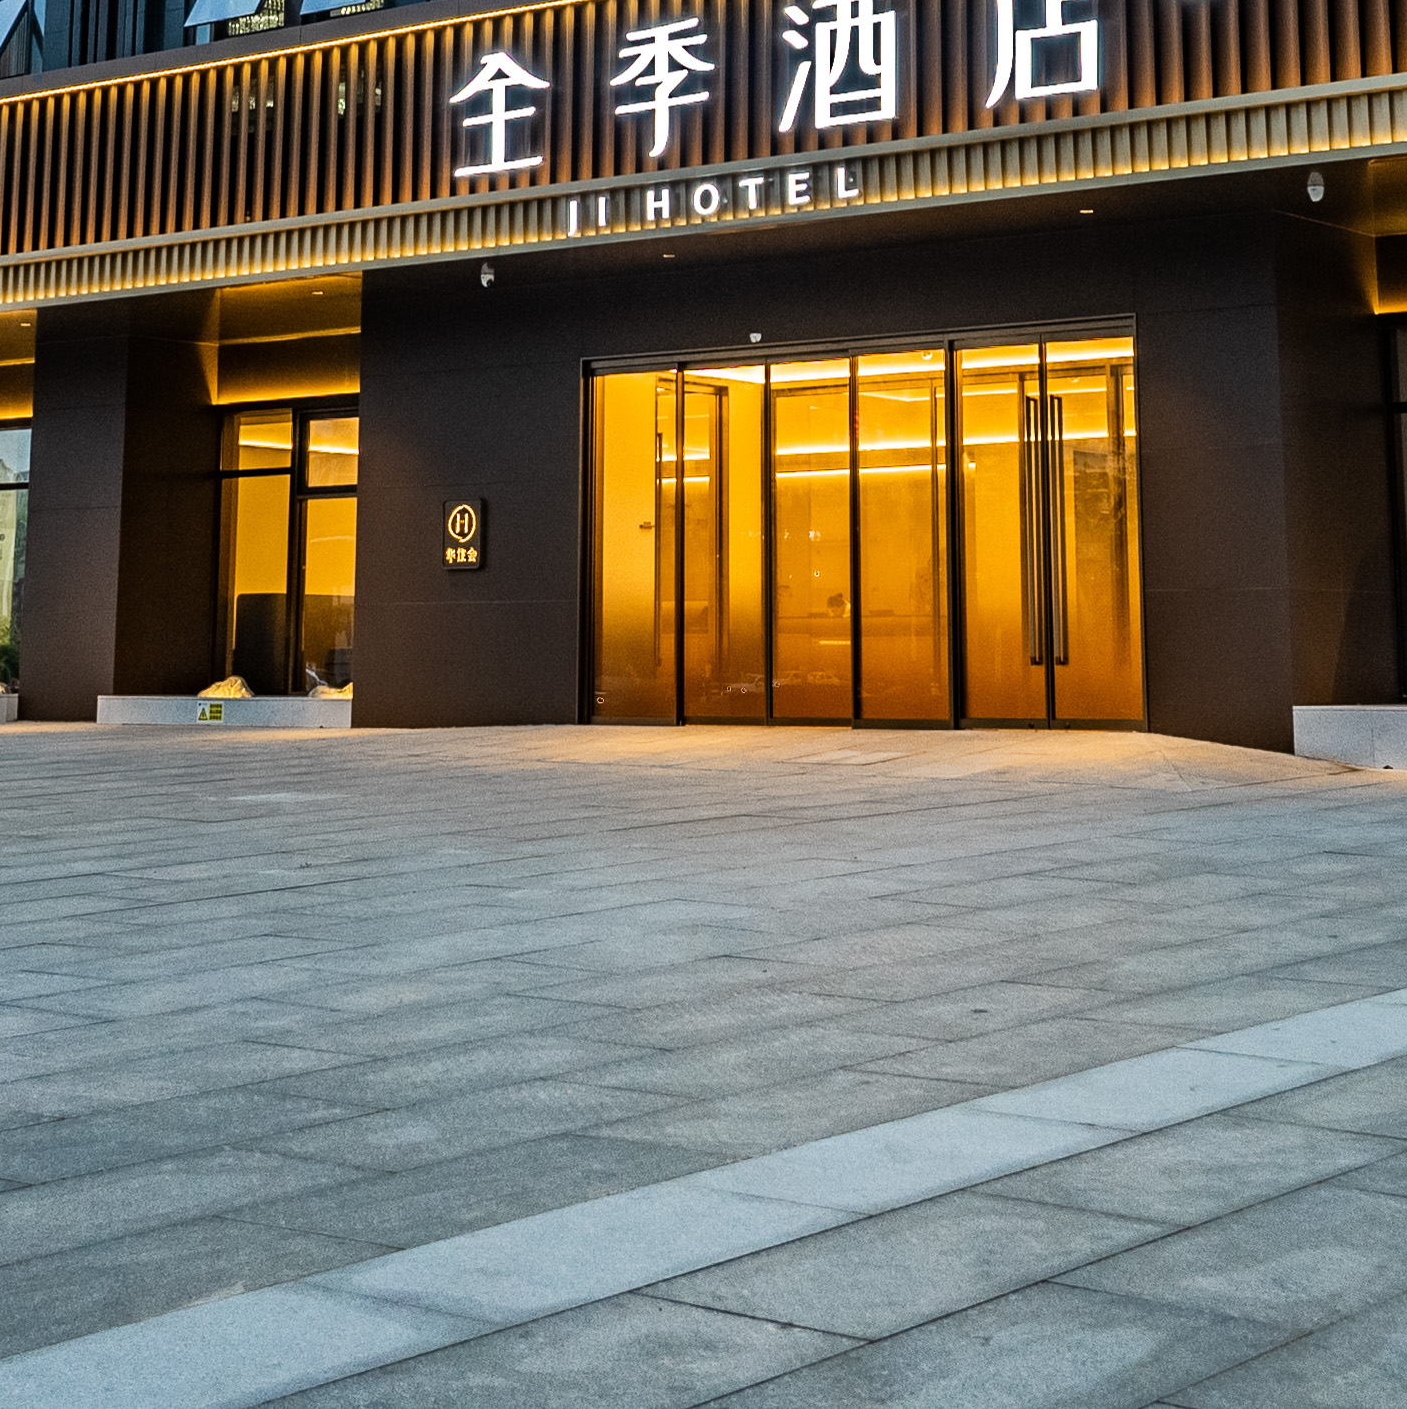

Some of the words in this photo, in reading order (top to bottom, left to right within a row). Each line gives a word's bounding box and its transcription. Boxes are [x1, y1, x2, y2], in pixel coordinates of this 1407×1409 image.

[567, 196, 608, 238] JI
[645, 166, 860, 222] HOTEL
[445, 546, 478, 564] 华住会
